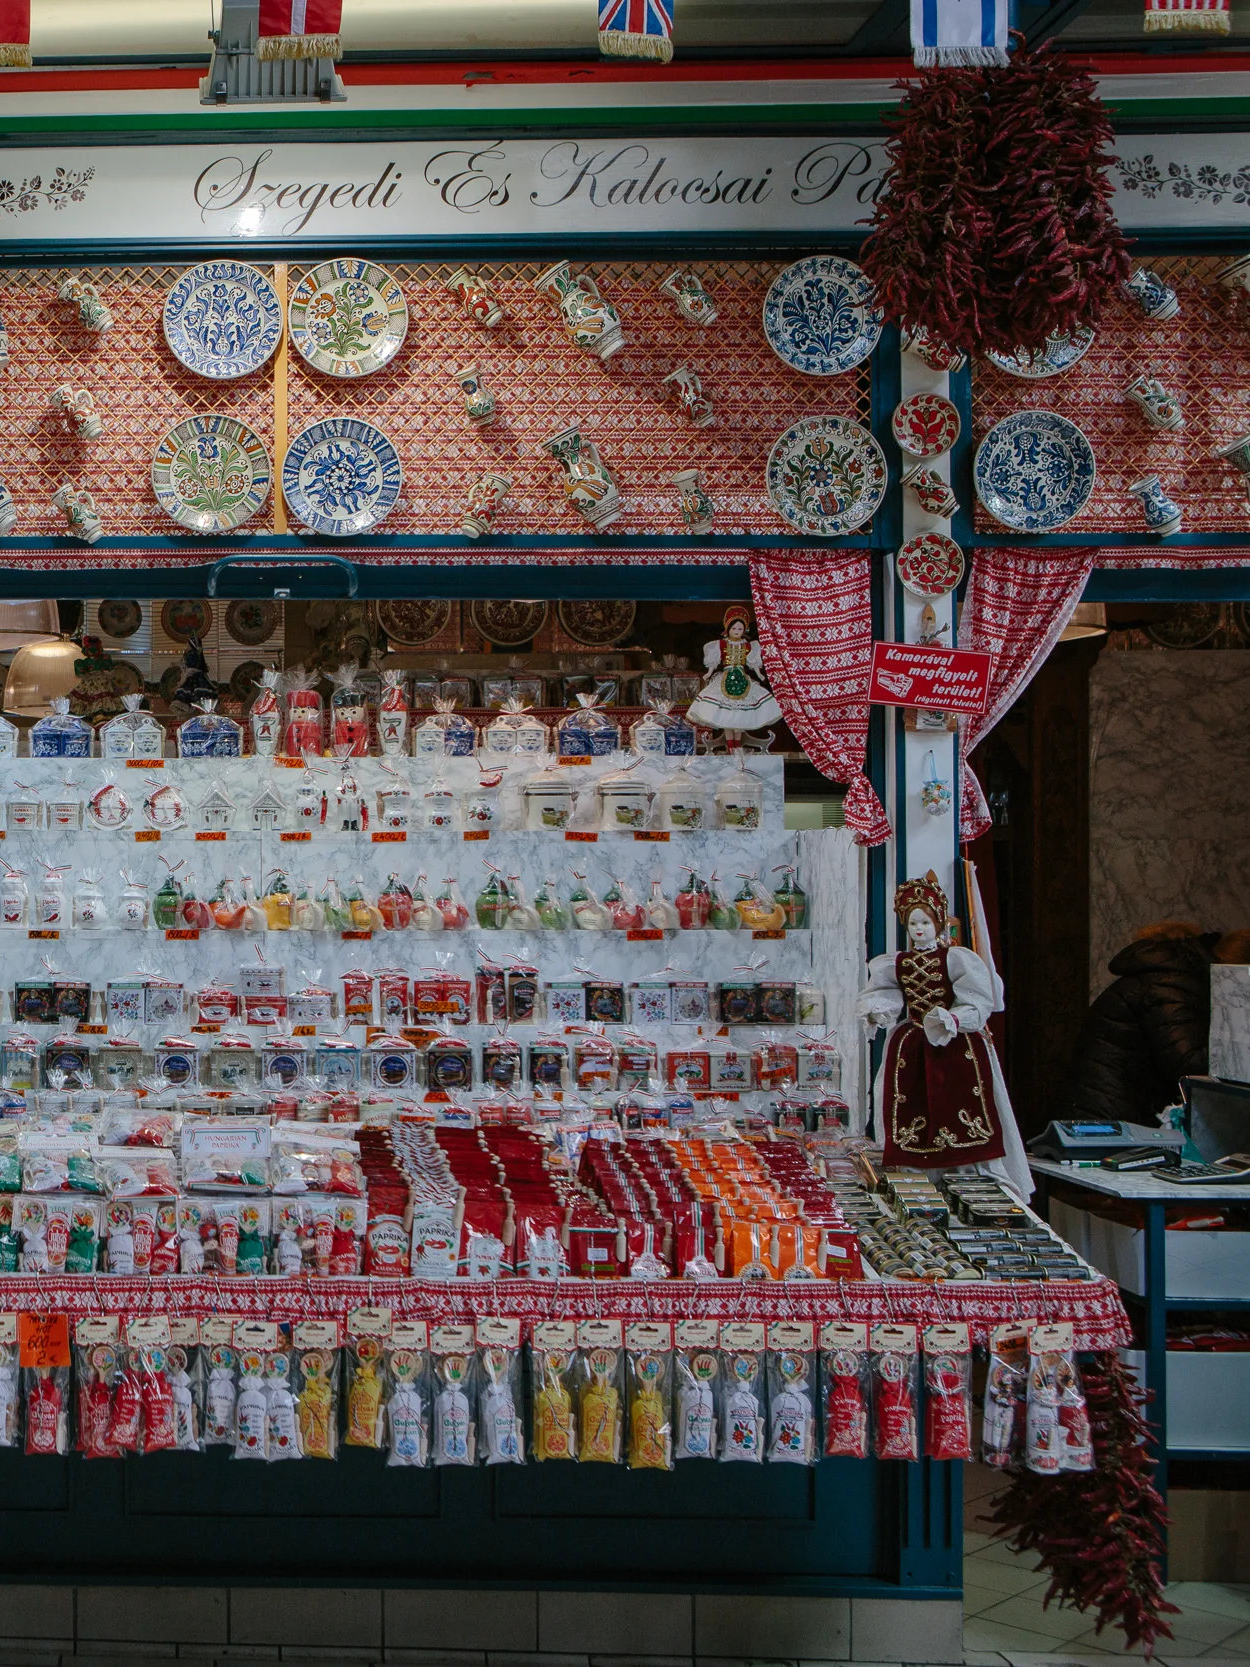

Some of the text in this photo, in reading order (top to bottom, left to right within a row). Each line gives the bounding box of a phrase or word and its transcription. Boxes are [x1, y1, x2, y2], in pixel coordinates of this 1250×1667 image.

[195, 149, 403, 237] Szegedi
[423, 141, 512, 215] És
[529, 142, 772, 209] Kalocsai
[885, 648, 955, 667] Kamerával
[908, 667, 979, 683] megfigyelt
[932, 683, 983, 699] terület!
[204, 1134, 247, 1143] HUNGARIAN
[211, 1141, 241, 1150] PAPRIKA
[372, 1231, 410, 1243] PAPRIKA
[419, 1226, 456, 1239] PAPRIKA
[36, 1324, 53, 1334] HOT
[36, 1350, 46, 1364] 2
[833, 1396, 861, 1406] PAPRIKA
[882, 1404, 911, 1412] PAPRIKA
[938, 1412, 966, 1424] Paprika
